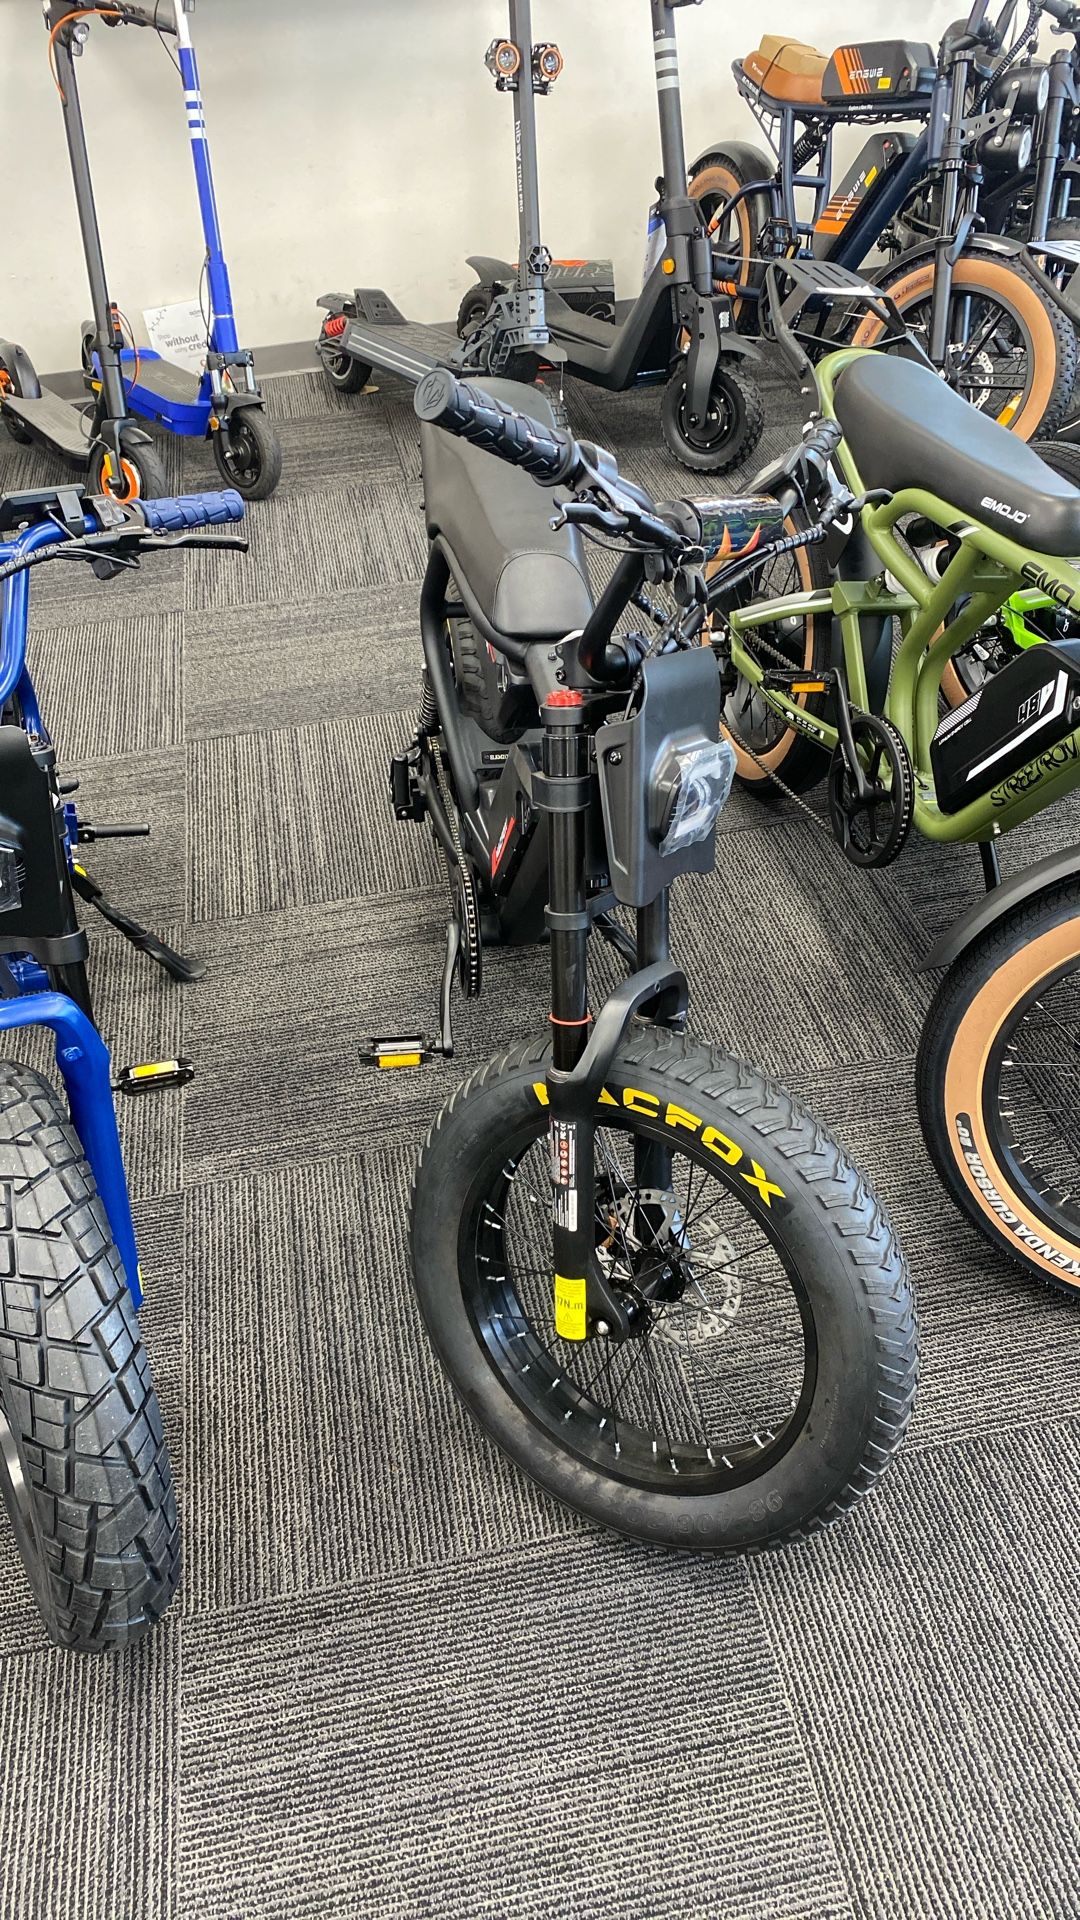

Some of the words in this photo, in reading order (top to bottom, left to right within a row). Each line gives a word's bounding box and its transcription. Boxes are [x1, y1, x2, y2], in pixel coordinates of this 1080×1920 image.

[165, 333, 200, 348] without
[188, 340, 208, 351] cred
[980, 496, 1027, 524] EMOJO
[1021, 561, 1080, 612] EMO
[1017, 679, 1056, 724] 48V
[964, 1151, 1019, 1225] CURSOR
[1013, 1223, 1080, 1278] KENDA
